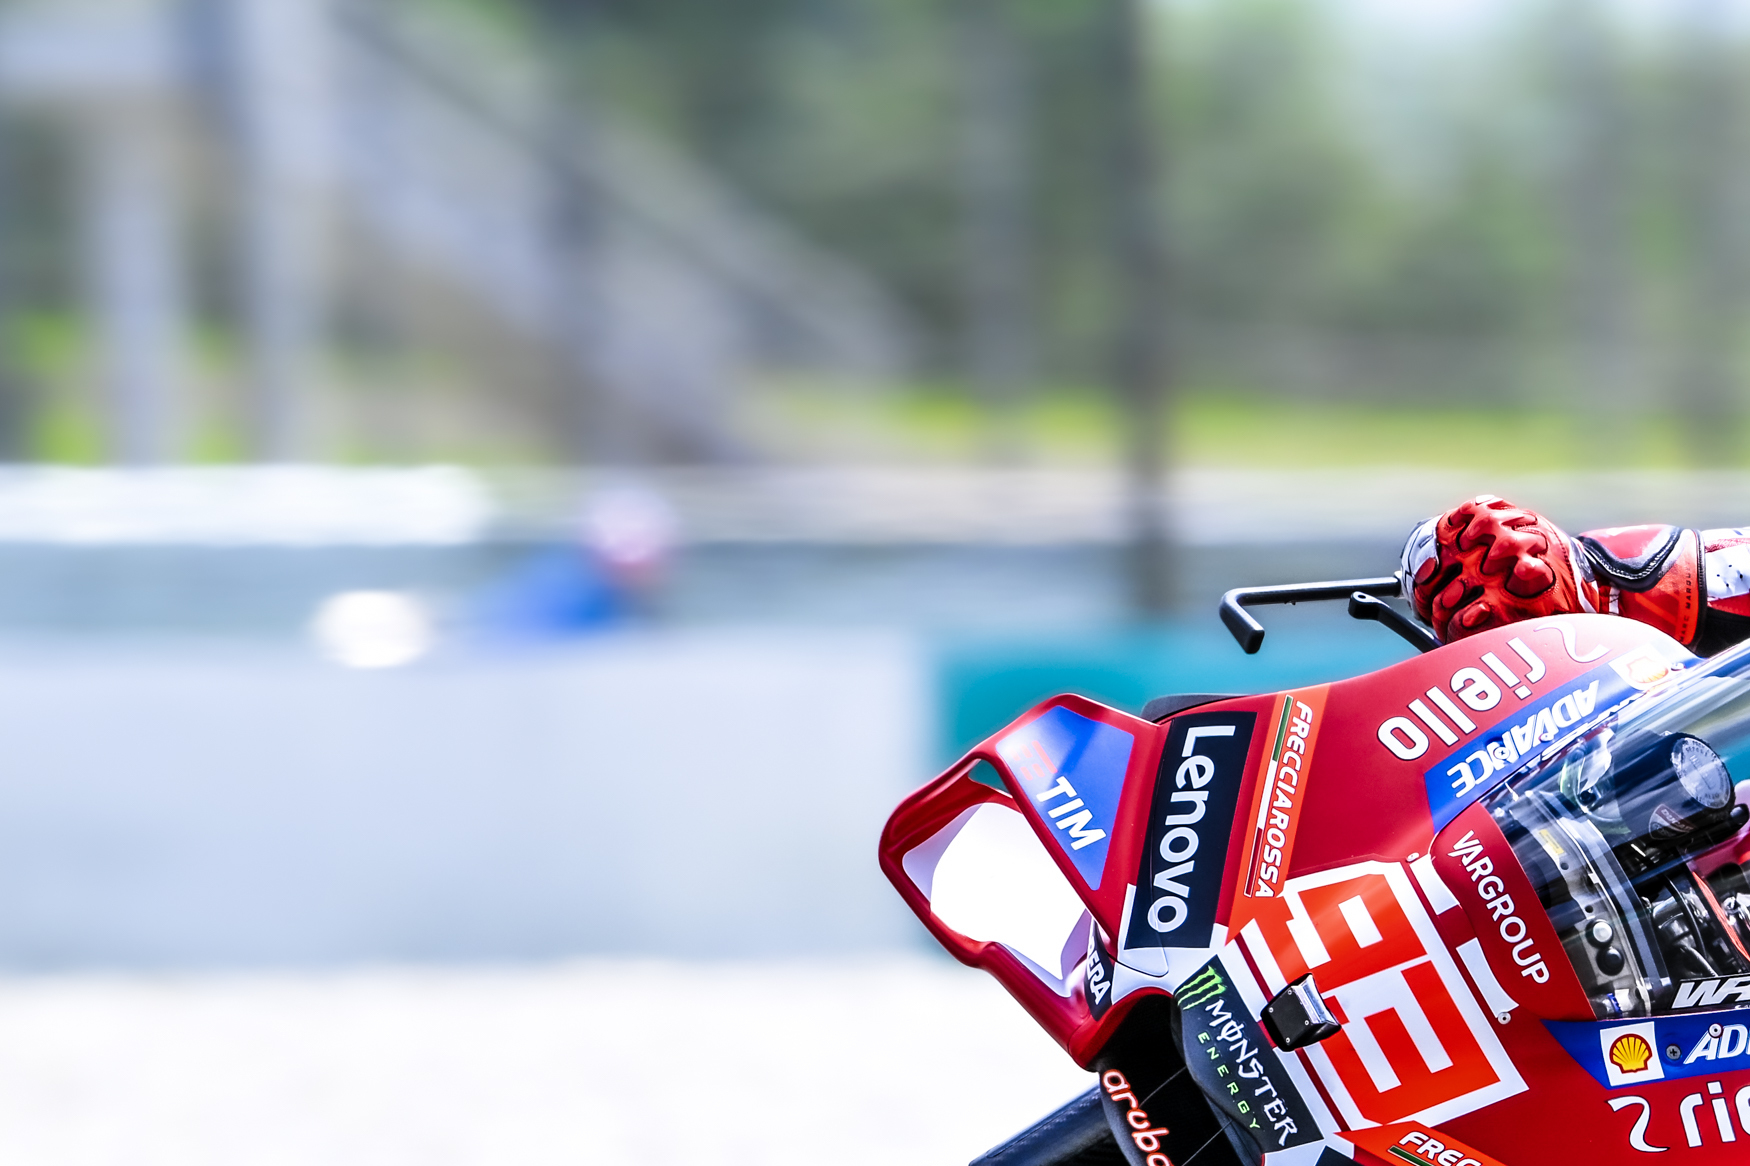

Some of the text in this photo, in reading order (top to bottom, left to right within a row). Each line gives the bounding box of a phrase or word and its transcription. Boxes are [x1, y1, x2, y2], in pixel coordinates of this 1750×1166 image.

[1377, 637, 1547, 761] riello
[1446, 680, 1599, 798] ADVANCE
[1036, 776, 1107, 851] TIM
[1147, 725, 1236, 933] Lenovo
[1255, 700, 1313, 898] FRECCIAROSSA
[1449, 830, 1550, 984] VARGROUP
[1198, 1031, 1260, 1131] ENERGY
